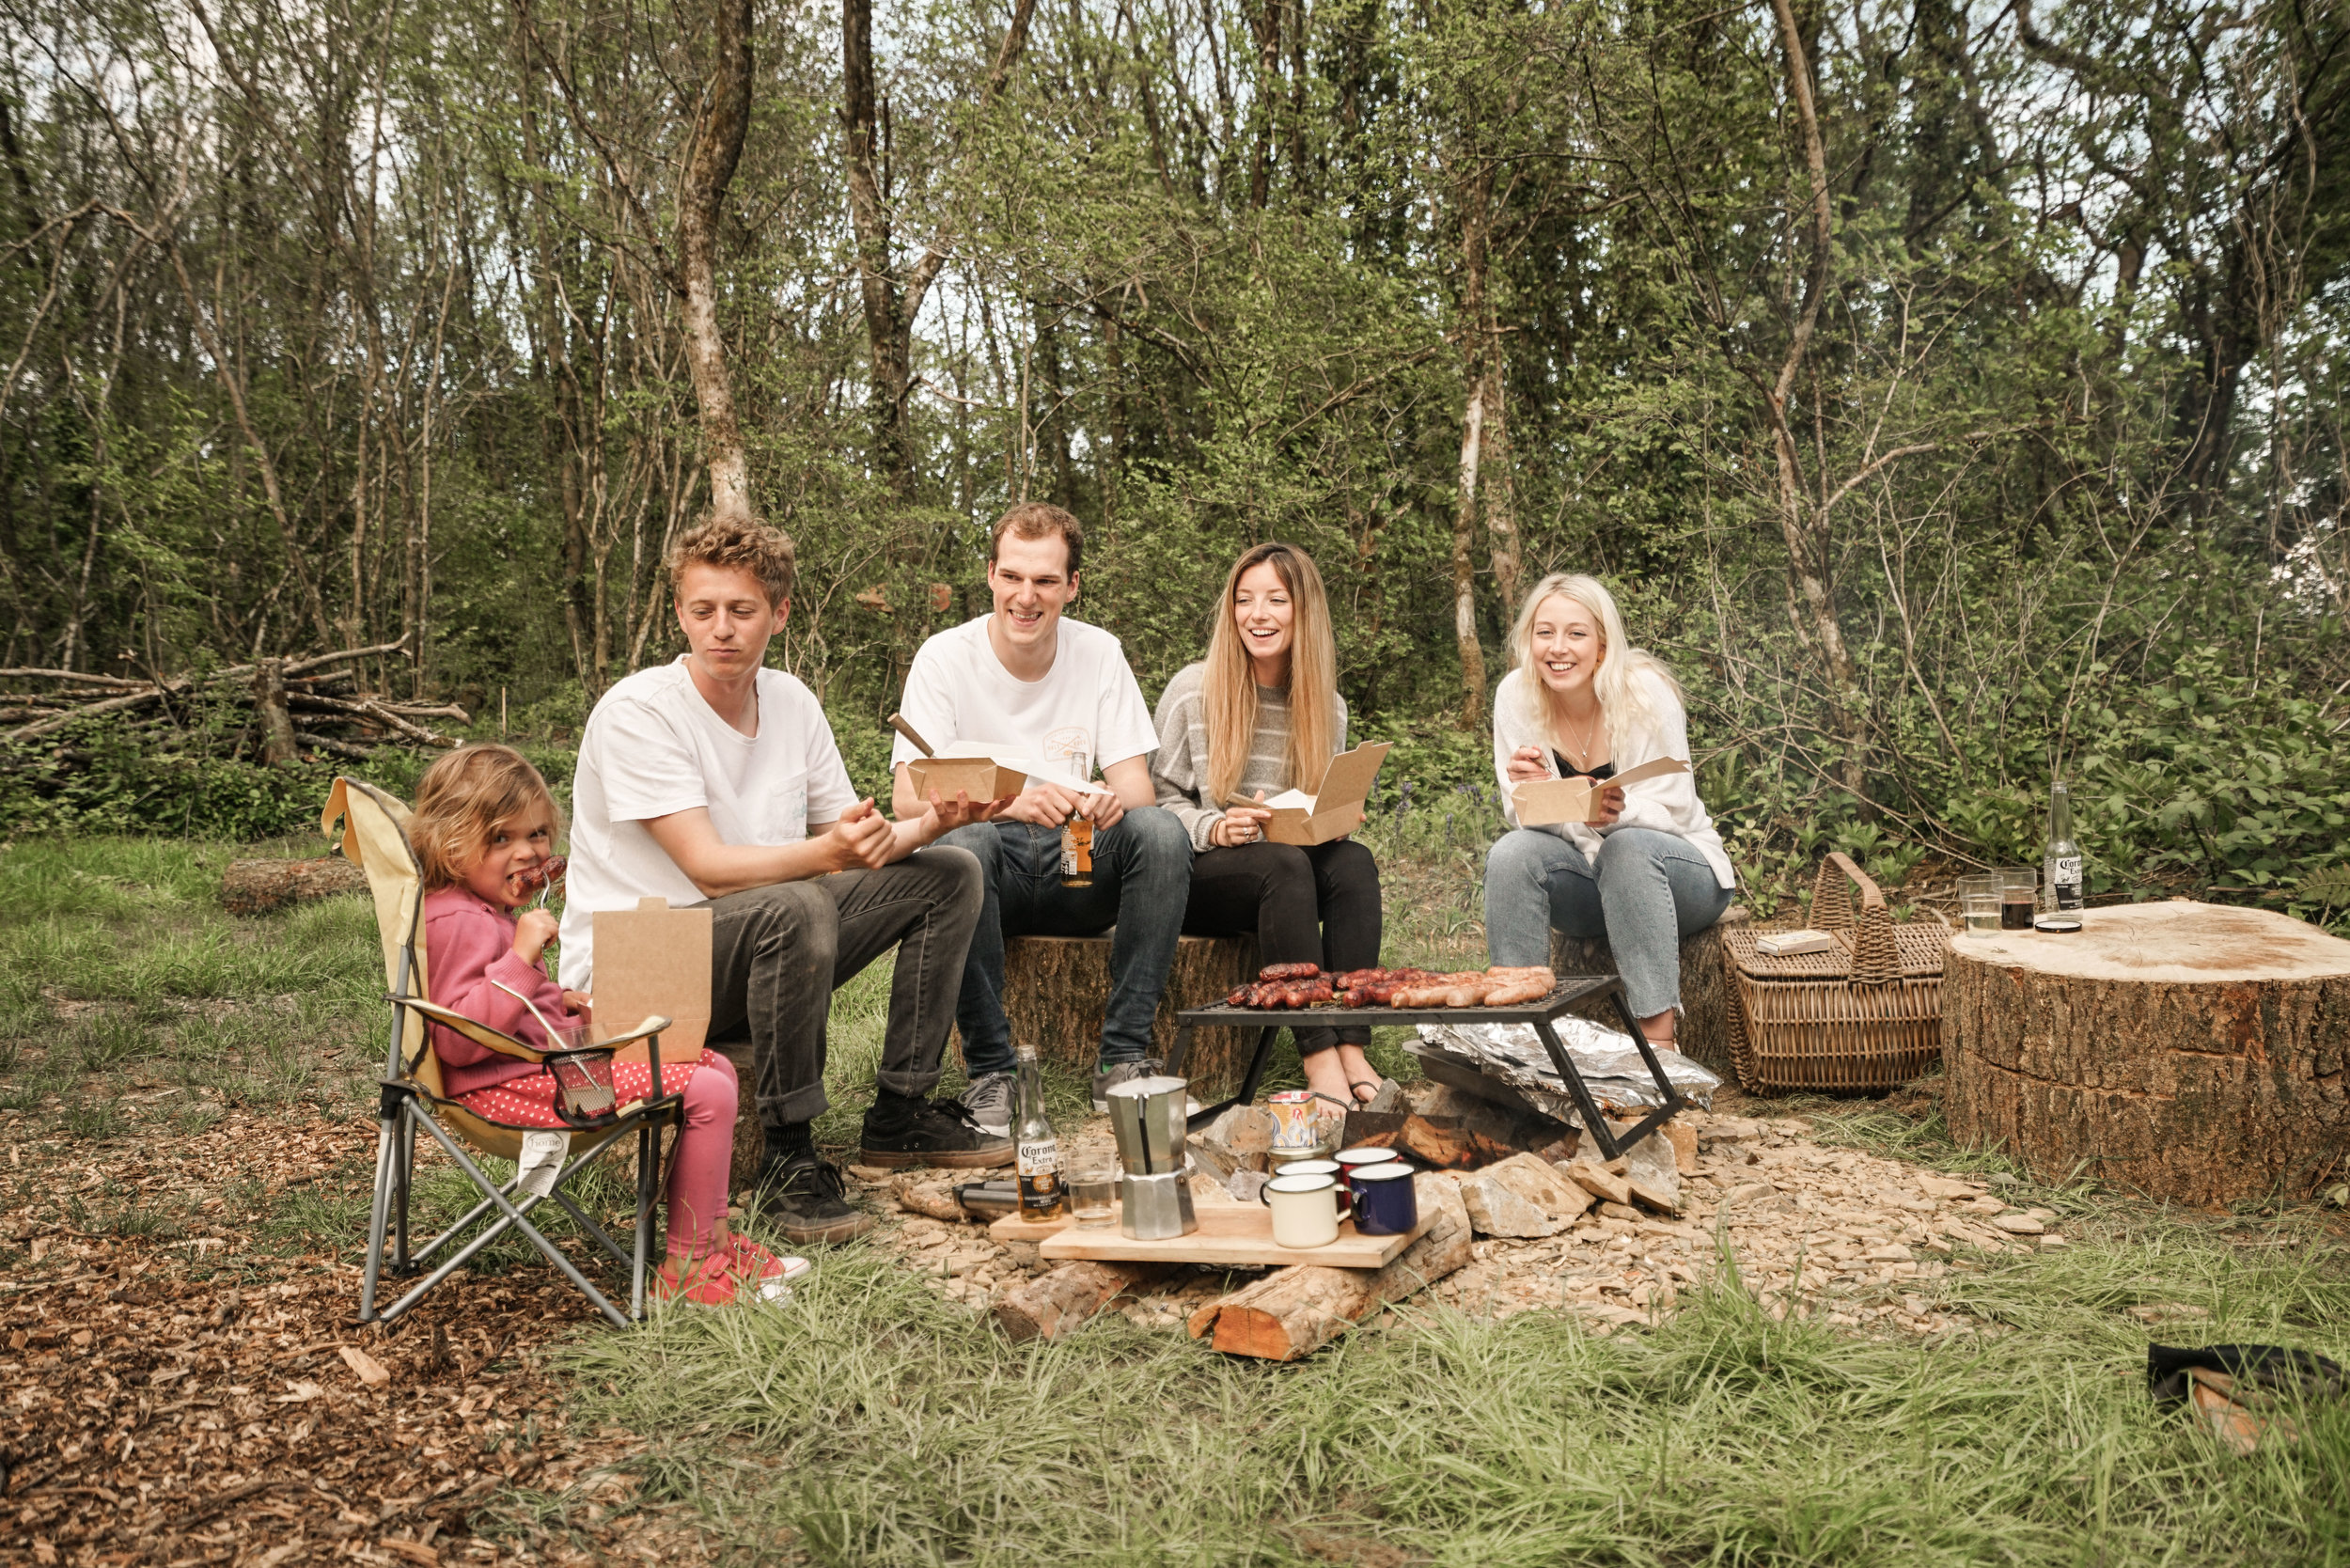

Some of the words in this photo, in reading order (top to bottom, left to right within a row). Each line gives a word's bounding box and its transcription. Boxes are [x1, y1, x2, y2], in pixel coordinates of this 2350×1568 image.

[530, 1138, 560, 1148] home
[1022, 1144, 1056, 1158] Corona
[1032, 1156, 1053, 1165] Extra
